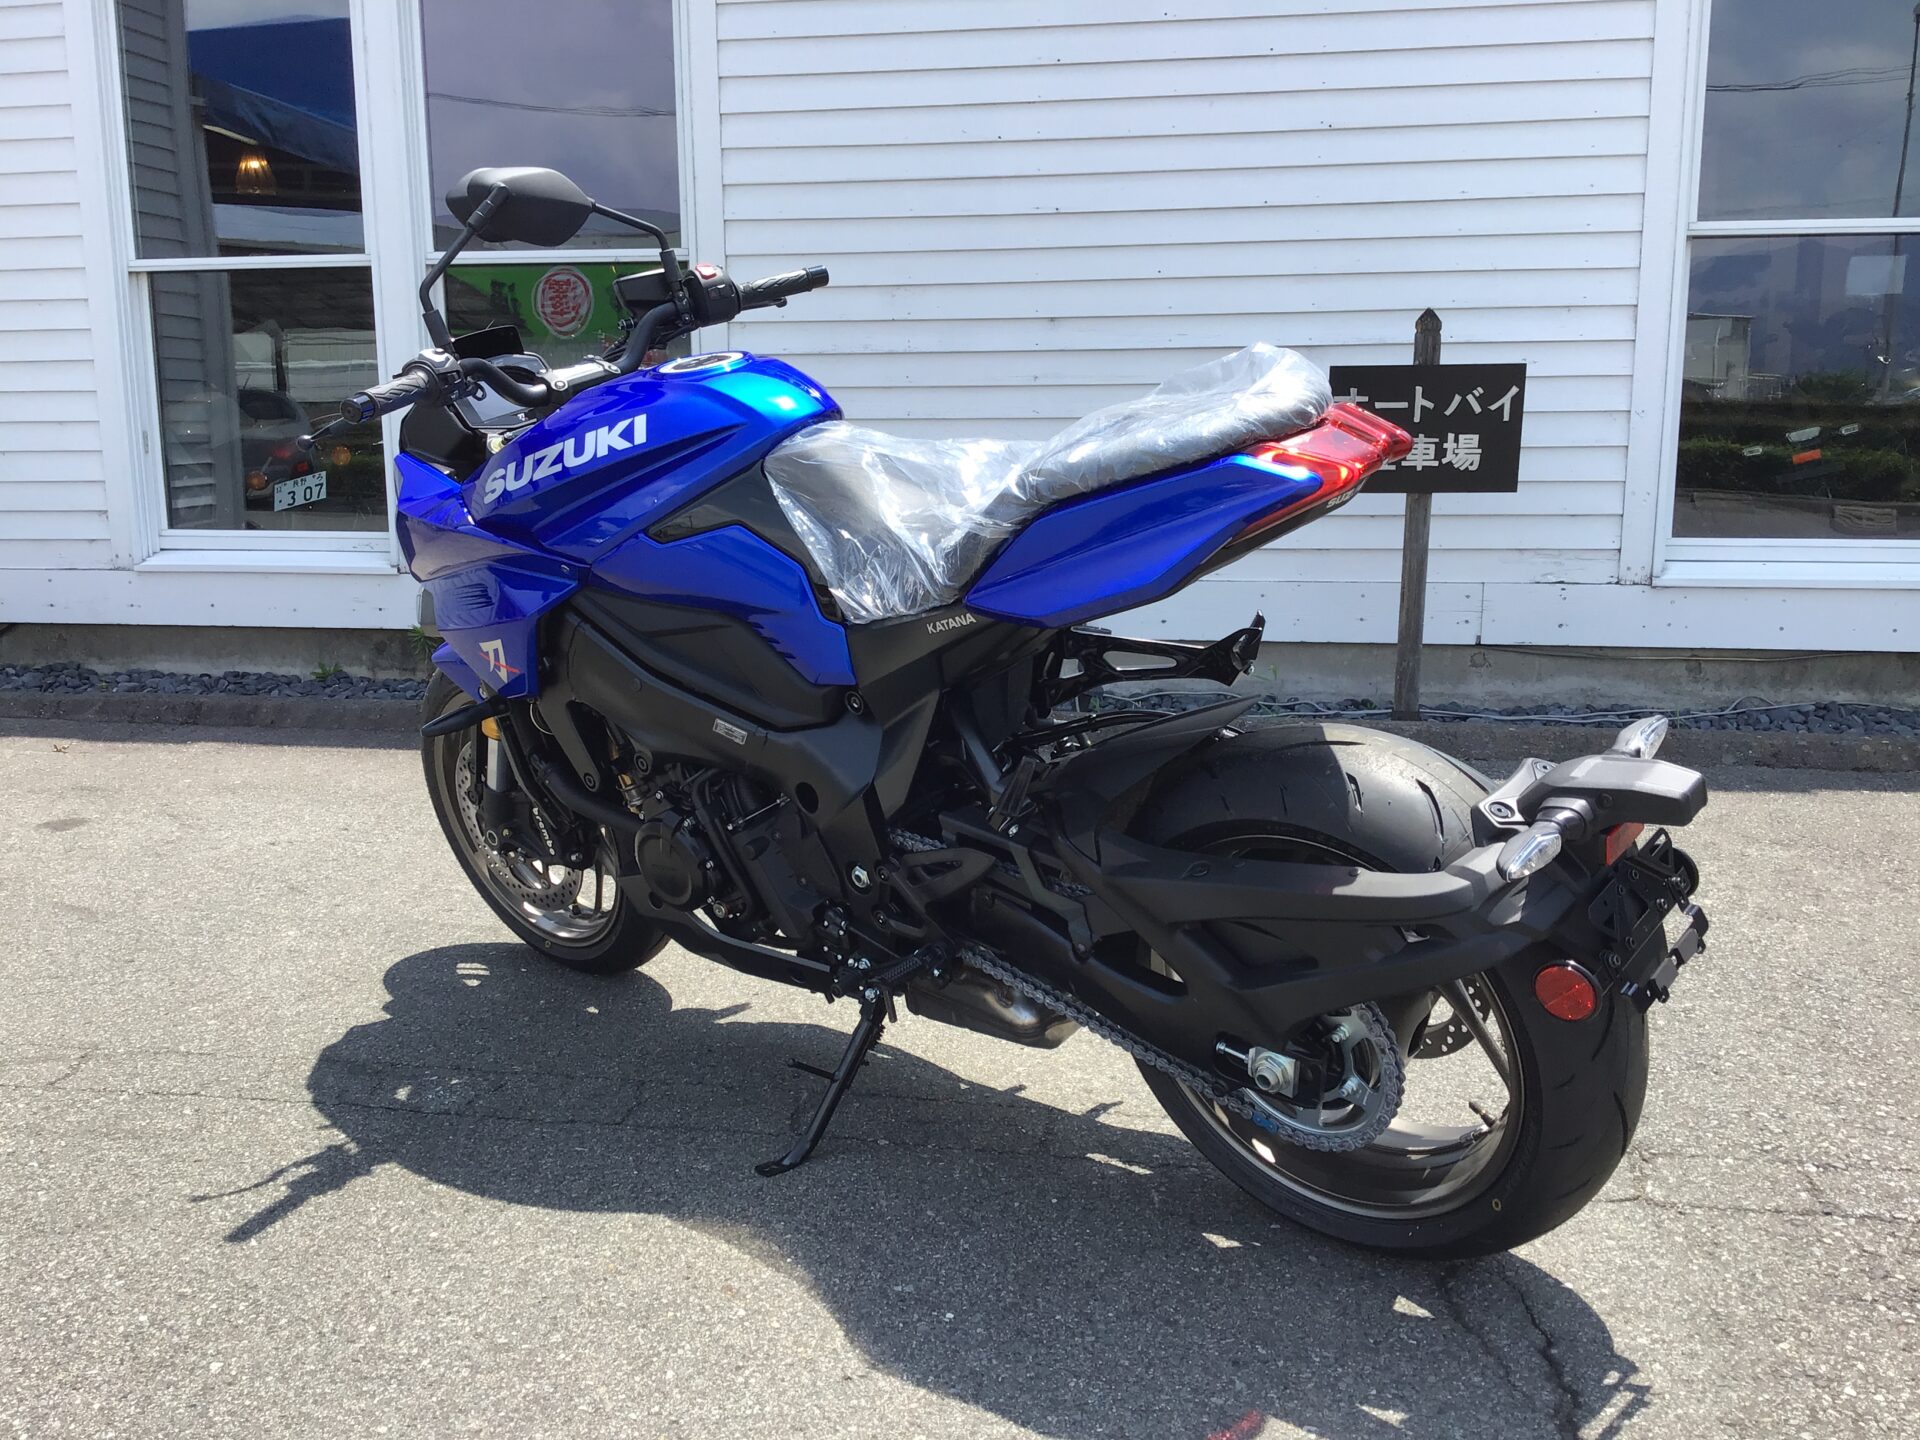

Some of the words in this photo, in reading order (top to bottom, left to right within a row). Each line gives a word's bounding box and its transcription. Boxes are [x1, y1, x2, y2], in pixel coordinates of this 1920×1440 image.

[484, 413, 647, 504] SUZUKI
[1379, 433, 1482, 471] 車場
[926, 612, 976, 634] KATANA
[532, 807, 555, 856] brembo
